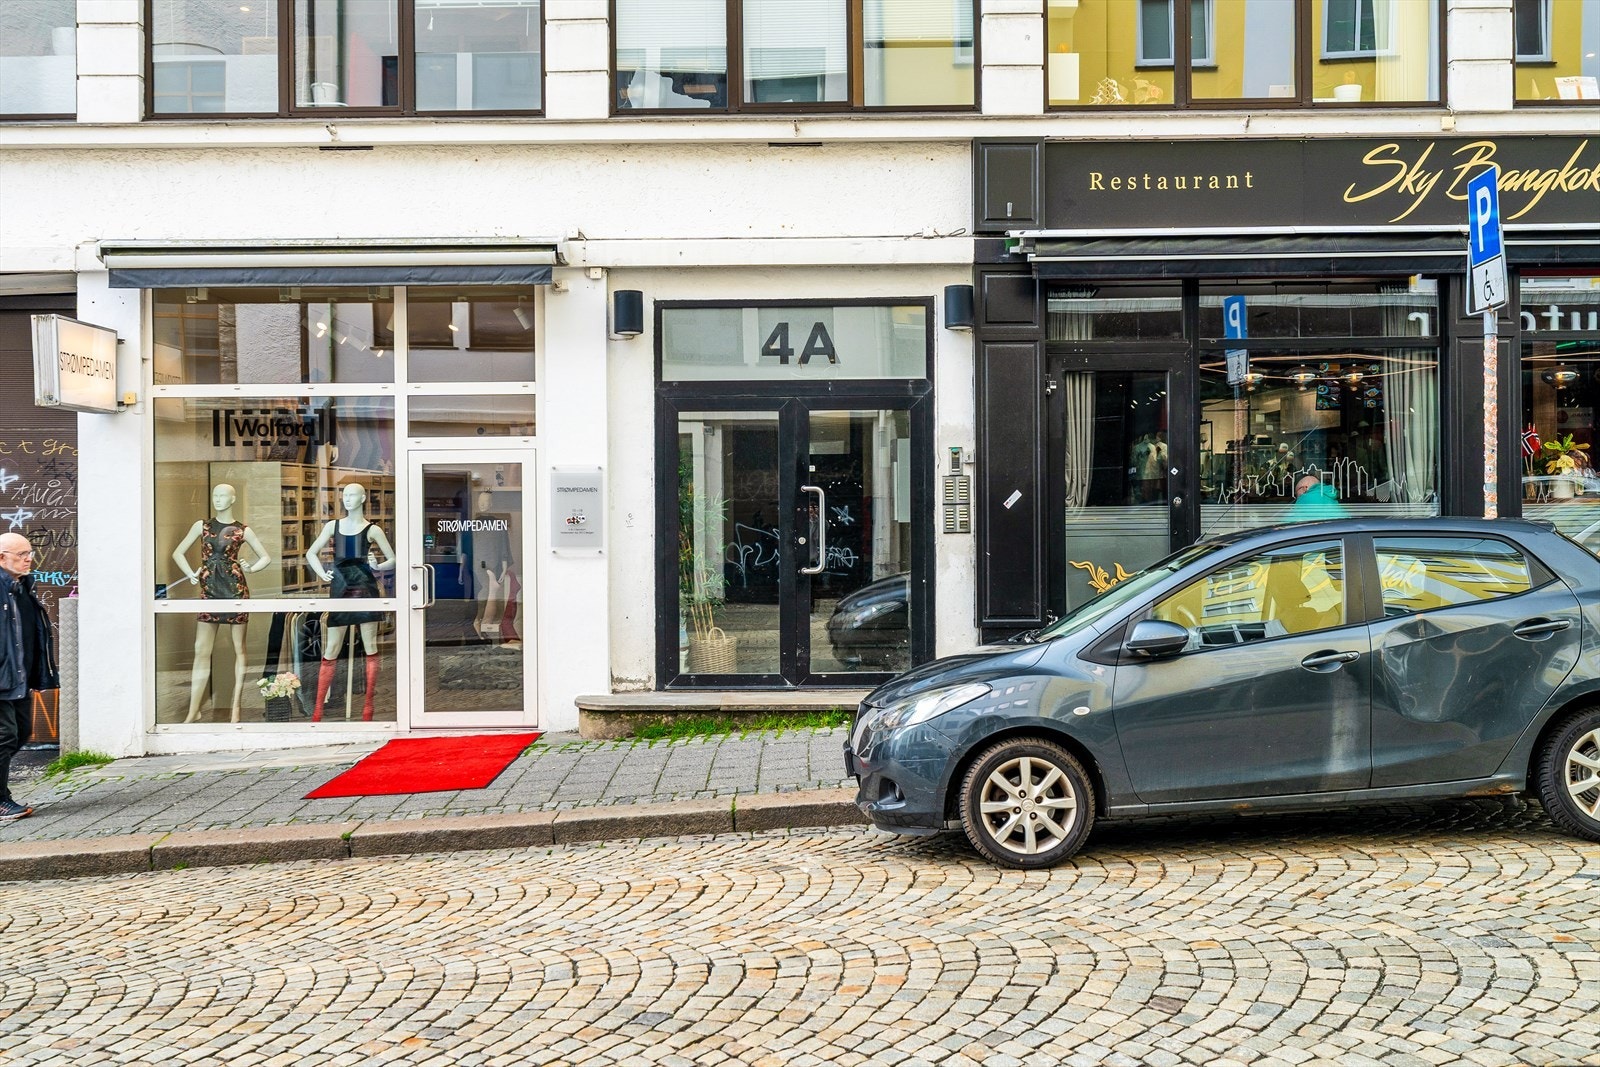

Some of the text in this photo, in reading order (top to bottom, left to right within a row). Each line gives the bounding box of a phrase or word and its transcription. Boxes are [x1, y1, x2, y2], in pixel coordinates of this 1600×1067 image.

[1089, 171, 1255, 191] Restaurant
[1343, 141, 1444, 223] Sky
[1476, 185, 1492, 252] P
[761, 322, 841, 365] 4A
[60, 351, 114, 380] STRØMPEDAMEN
[233, 417, 315, 437] Wolford
[437, 519, 508, 532] STRØMPEDAMEN
